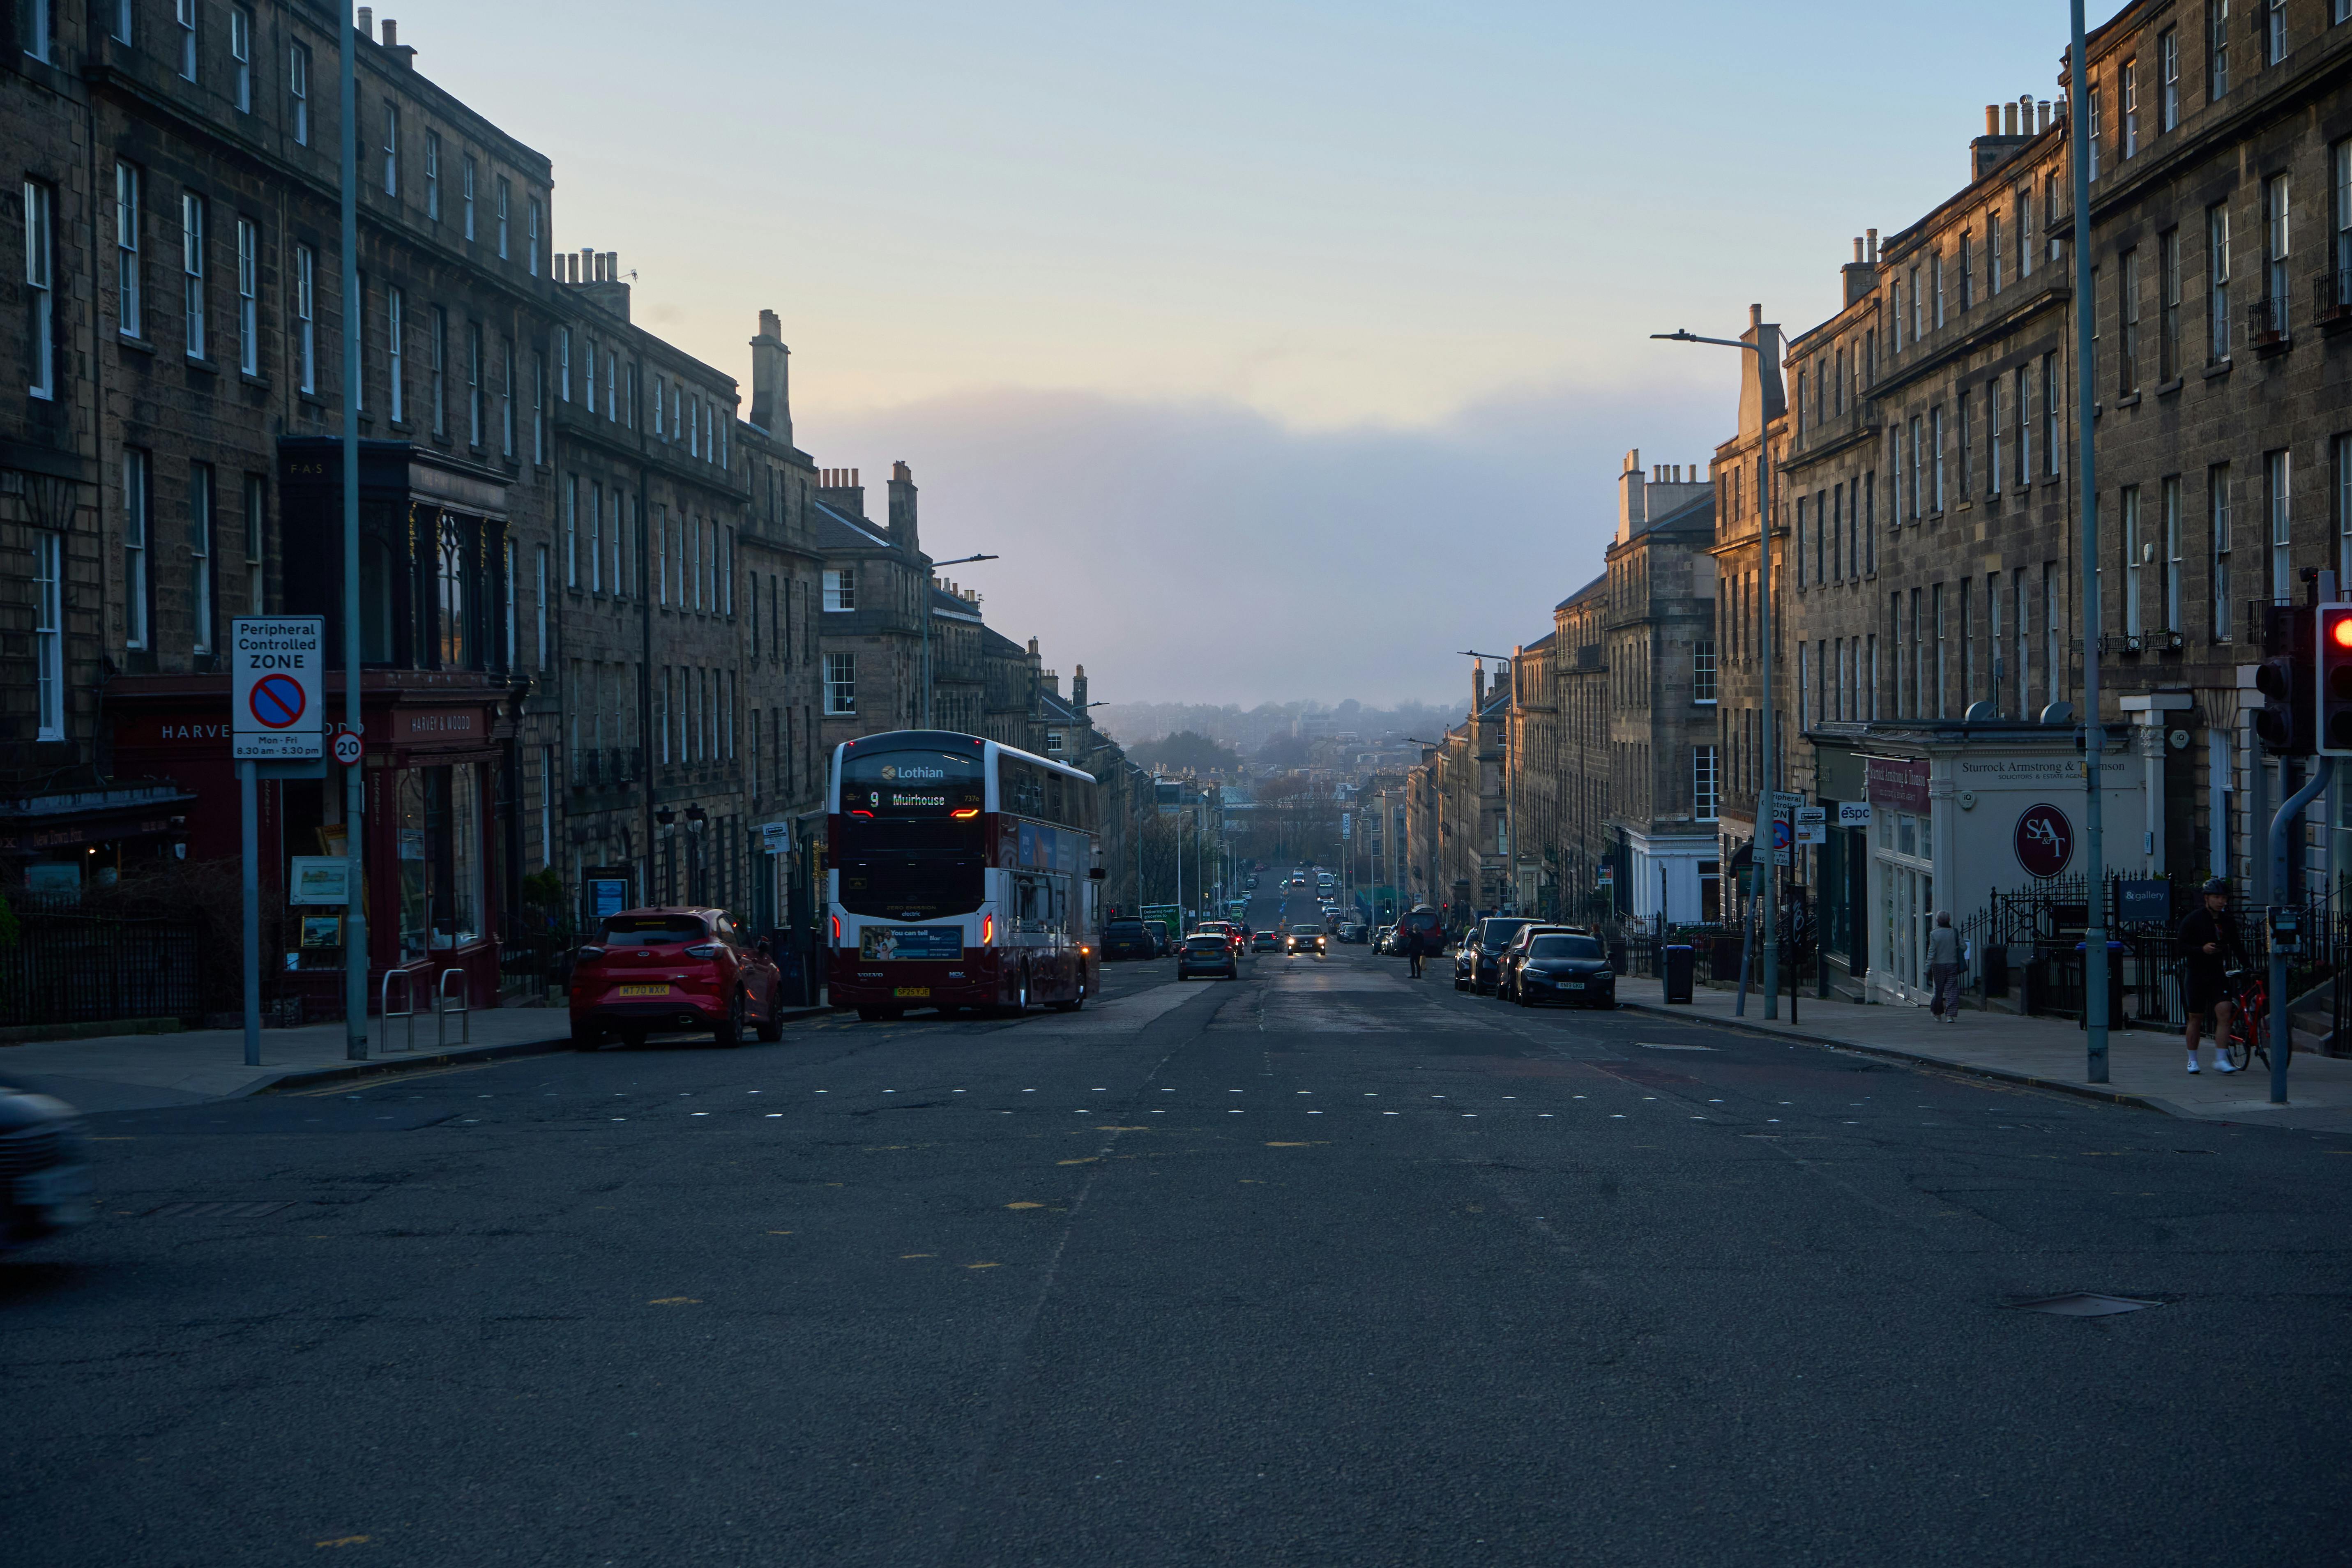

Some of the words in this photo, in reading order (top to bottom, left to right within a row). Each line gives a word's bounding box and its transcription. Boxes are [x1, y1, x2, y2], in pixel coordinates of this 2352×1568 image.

[240, 624, 315, 636] Peripheral
[239, 639, 316, 650] Controlled
[250, 655, 304, 668] ZONE
[412, 716, 436, 732] HARVEY
[440, 716, 444, 730] &
[162, 725, 230, 739] HARVE
[337, 741, 359, 755] 20
[898, 767, 943, 778] Lothian
[1962, 762, 2005, 772] Sturrock
[2008, 762, 2062, 774] Armstrong
[2065, 761, 2074, 771] &
[2078, 761, 2125, 771] Tmson
[1870, 764, 1884, 781] Sturrock
[1885, 767, 1903, 787] Armstrong
[1904, 769, 1908, 784] &
[1909, 769, 1926, 787] Thomson
[871, 791, 879, 808] 9
[893, 794, 944, 806] Muirhouse
[1841, 807, 1870, 821] espc
